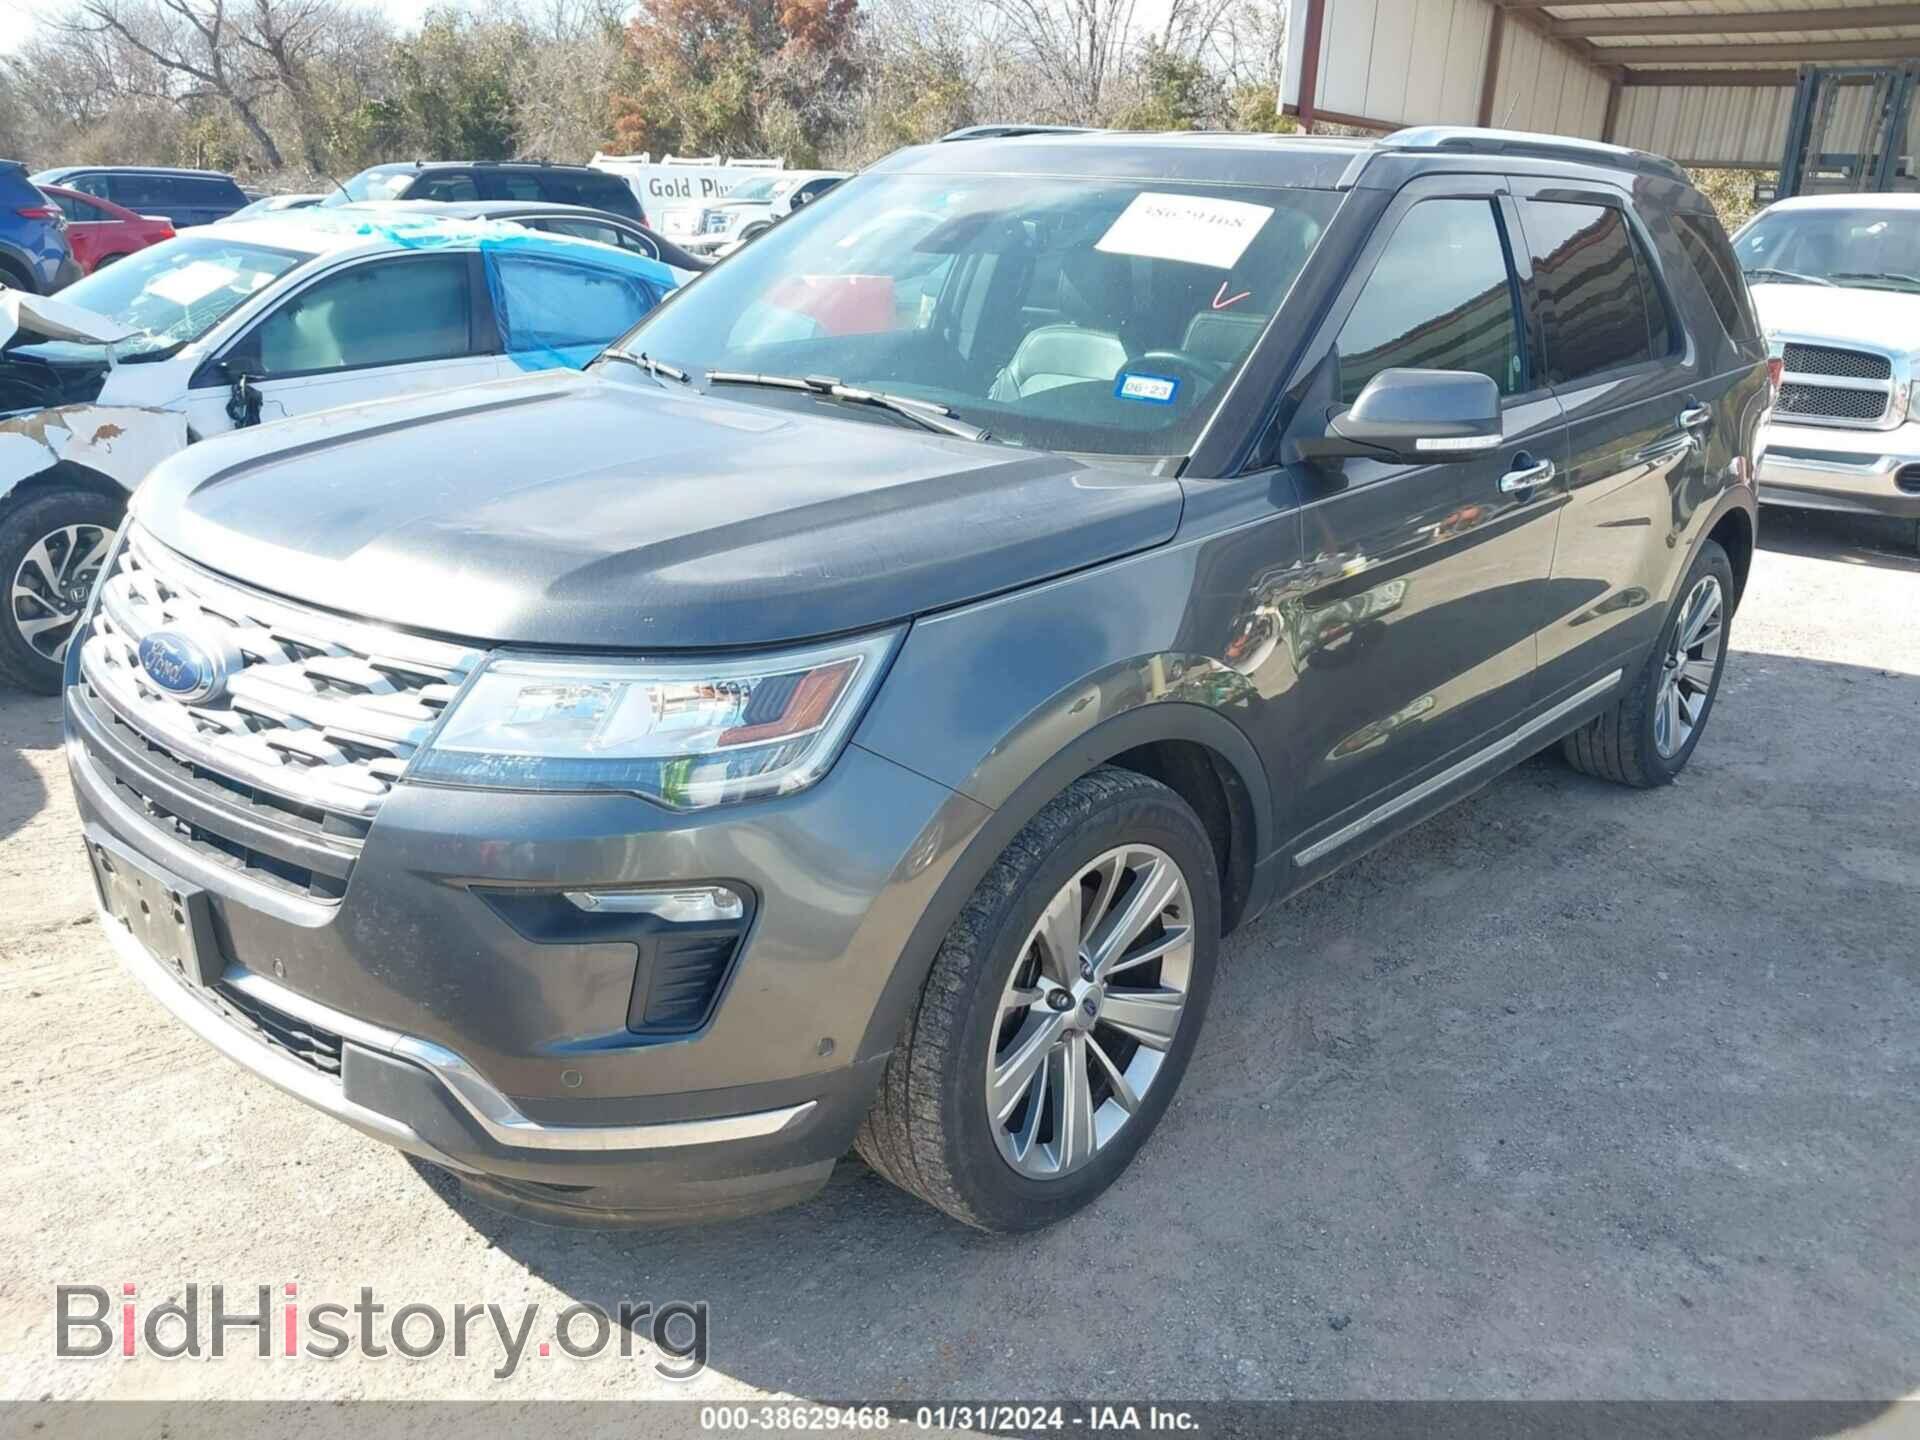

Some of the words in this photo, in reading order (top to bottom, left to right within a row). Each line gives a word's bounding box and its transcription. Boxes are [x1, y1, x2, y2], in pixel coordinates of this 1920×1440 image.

[648, 177, 690, 198] Gold
[699, 177, 733, 199] Plu
[143, 639, 186, 684] Ford
